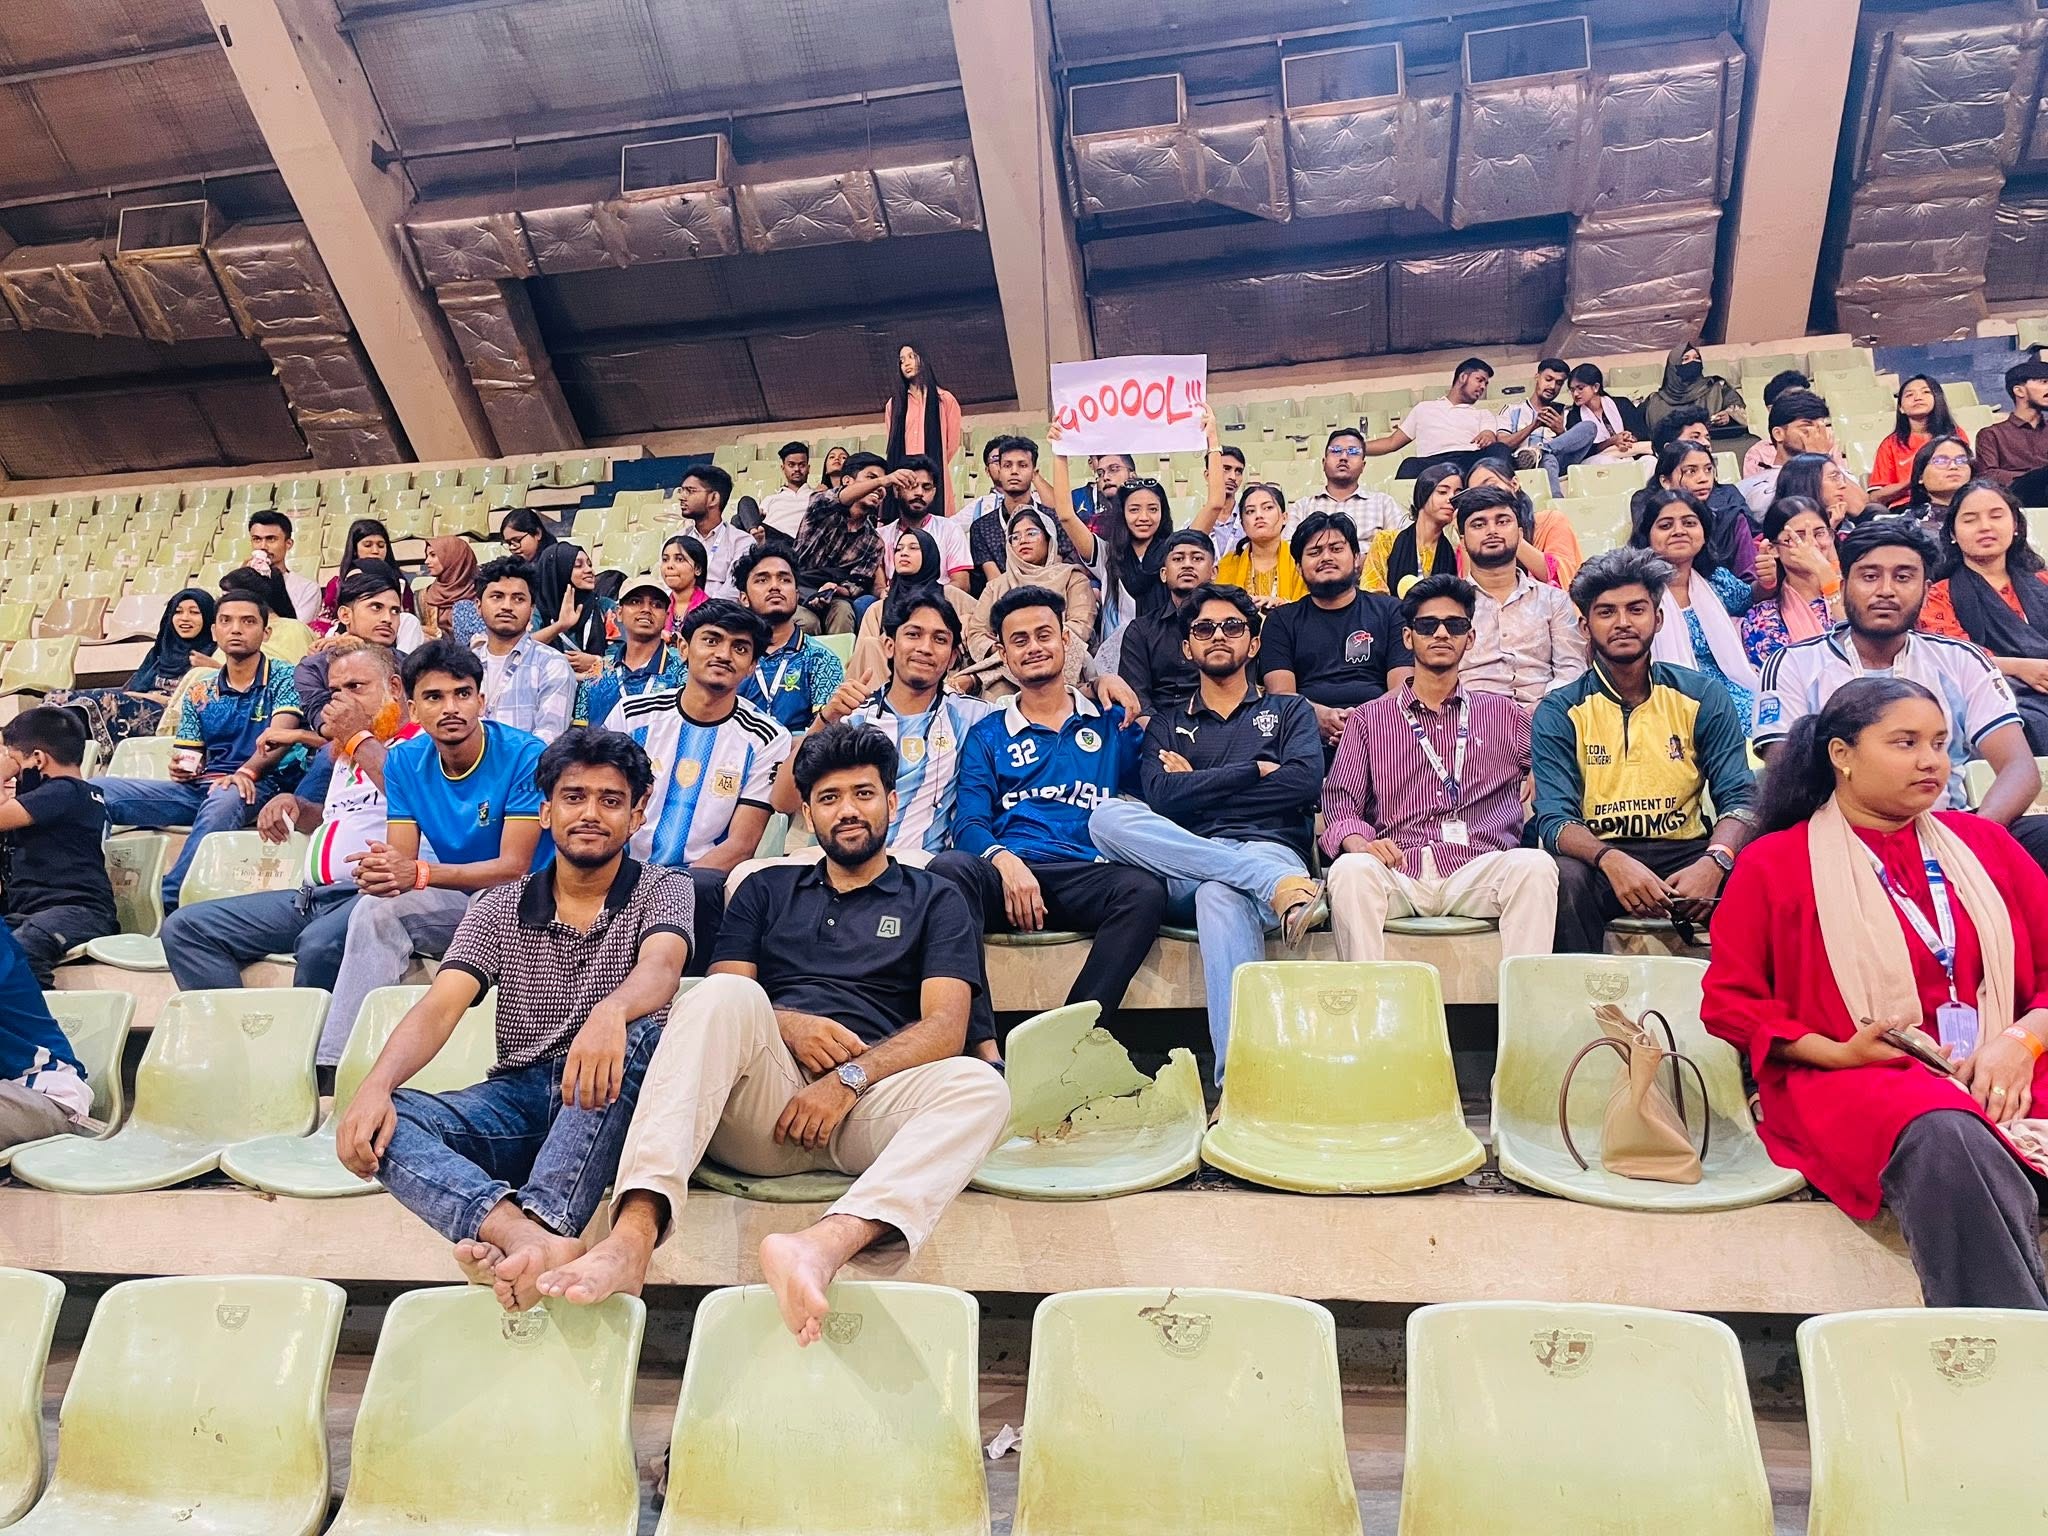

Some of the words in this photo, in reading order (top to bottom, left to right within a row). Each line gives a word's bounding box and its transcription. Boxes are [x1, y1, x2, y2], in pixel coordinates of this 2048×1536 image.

[1007, 738, 1040, 768] 32
[1595, 798, 1662, 816] DEPARTMENT
[1665, 797, 1677, 809] OF
[1584, 809, 1688, 838] CONOMICS
[880, 919, 896, 935] A
